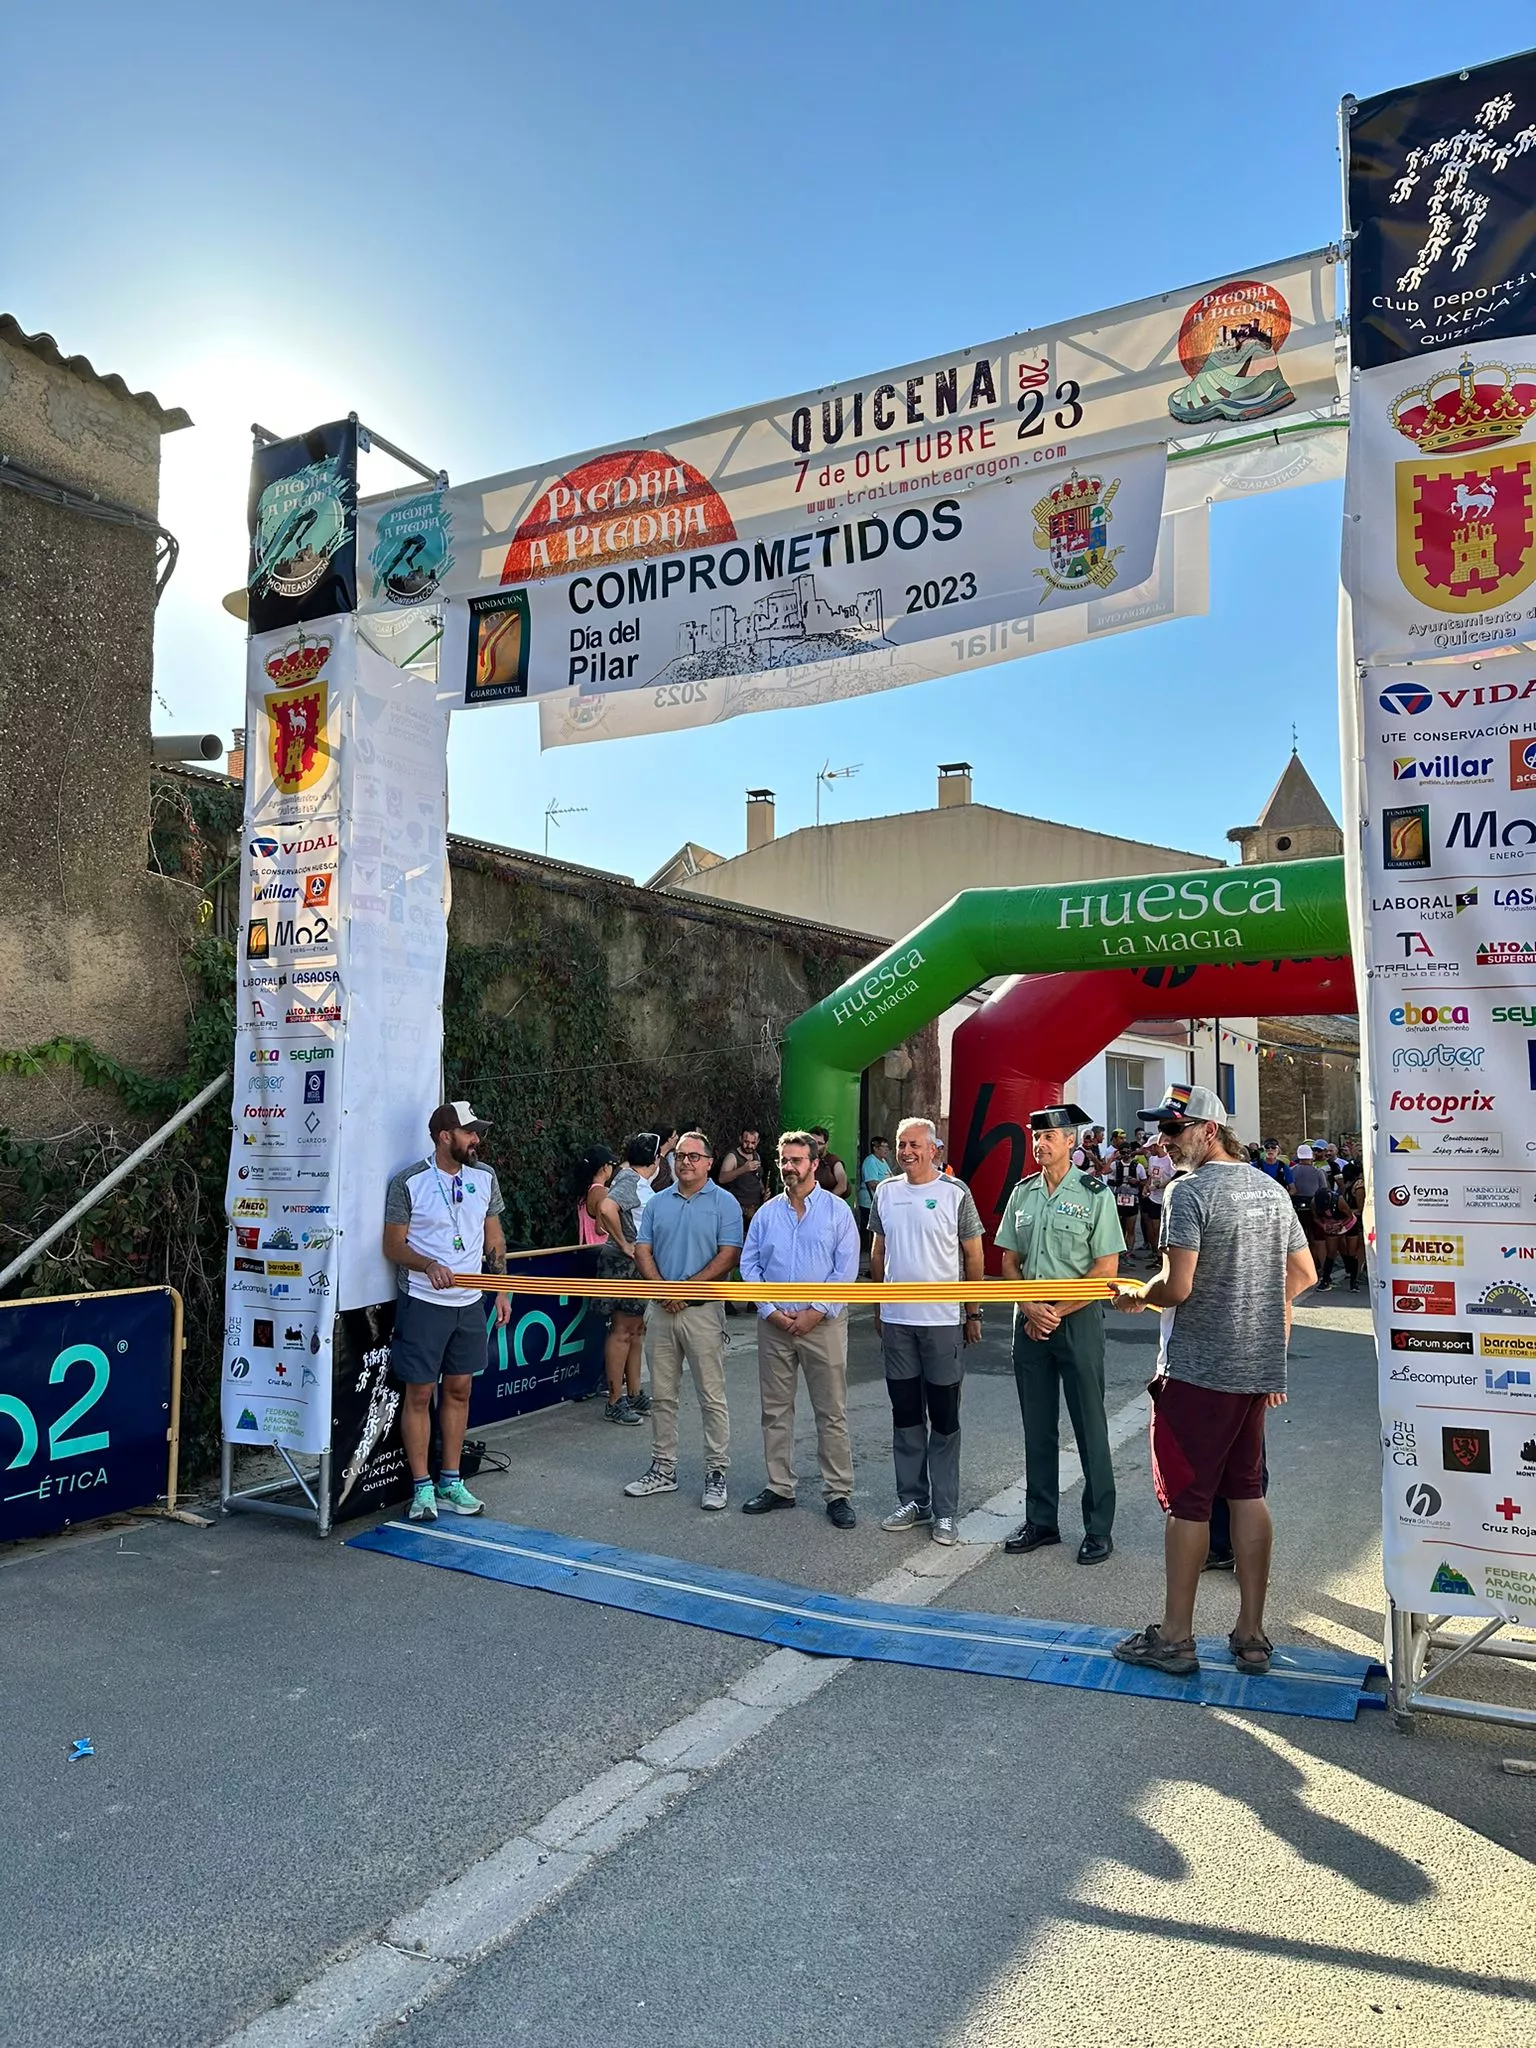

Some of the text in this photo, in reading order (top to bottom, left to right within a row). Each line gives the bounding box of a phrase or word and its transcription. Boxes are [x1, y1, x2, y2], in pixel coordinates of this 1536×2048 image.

[1372, 296, 1419, 312] Club
[1420, 317, 1496, 345] QUIZENA
[790, 359, 997, 453] QUICENA
[1017, 380, 1084, 440] 23
[794, 418, 997, 493] 7 de OCTUBRE
[806, 444, 1068, 515] www.trailmontearagon.com
[546, 463, 689, 526] PIEDRA
[526, 502, 711, 580] A PIEDRA
[568, 498, 963, 616] COMPROMETIDOS
[473, 594, 523, 611] FUNDACIÓN
[905, 571, 978, 614] 2023
[1408, 611, 1522, 636] Ayuntamiento
[569, 617, 641, 652] Día del
[1434, 627, 1517, 649] Quicena
[568, 653, 640, 686] Pilar
[470, 685, 522, 698] GUARDIA CIVIL
[1381, 723, 1519, 743] UTE CONSERVACIÓN
[1418, 755, 1494, 778] villar
[281, 834, 338, 855] VIDAL
[1056, 876, 1286, 930] Huesca
[1372, 895, 1453, 911] LABORAL
[1494, 888, 1536, 906] LAS
[1420, 911, 1454, 921] kutxa
[1476, 941, 1536, 954] ALTOA
[1375, 963, 1460, 973] TRALLERO
[1487, 954, 1536, 965] SUPERM
[292, 971, 340, 984] LASAOSA
[831, 948, 926, 1026] Huesca
[1389, 1002, 1470, 1026] eboca
[1392, 1044, 1485, 1067] raster
[1389, 1089, 1496, 1116] fotoprix
[1442, 1134, 1490, 1143] Construcciones
[1413, 1185, 1449, 1198] feyma
[1400, 1237, 1455, 1254] ANETO
[1409, 1255, 1448, 1263] NATURAL
[1408, 1337, 1471, 1350] forum sport
[1484, 1348, 1529, 1357] OUTLET STORE
[1409, 1371, 1479, 1387] ecomputer
[1481, 1523, 1536, 1538] Cruz Roja
[1486, 1588, 1504, 1600] DE
